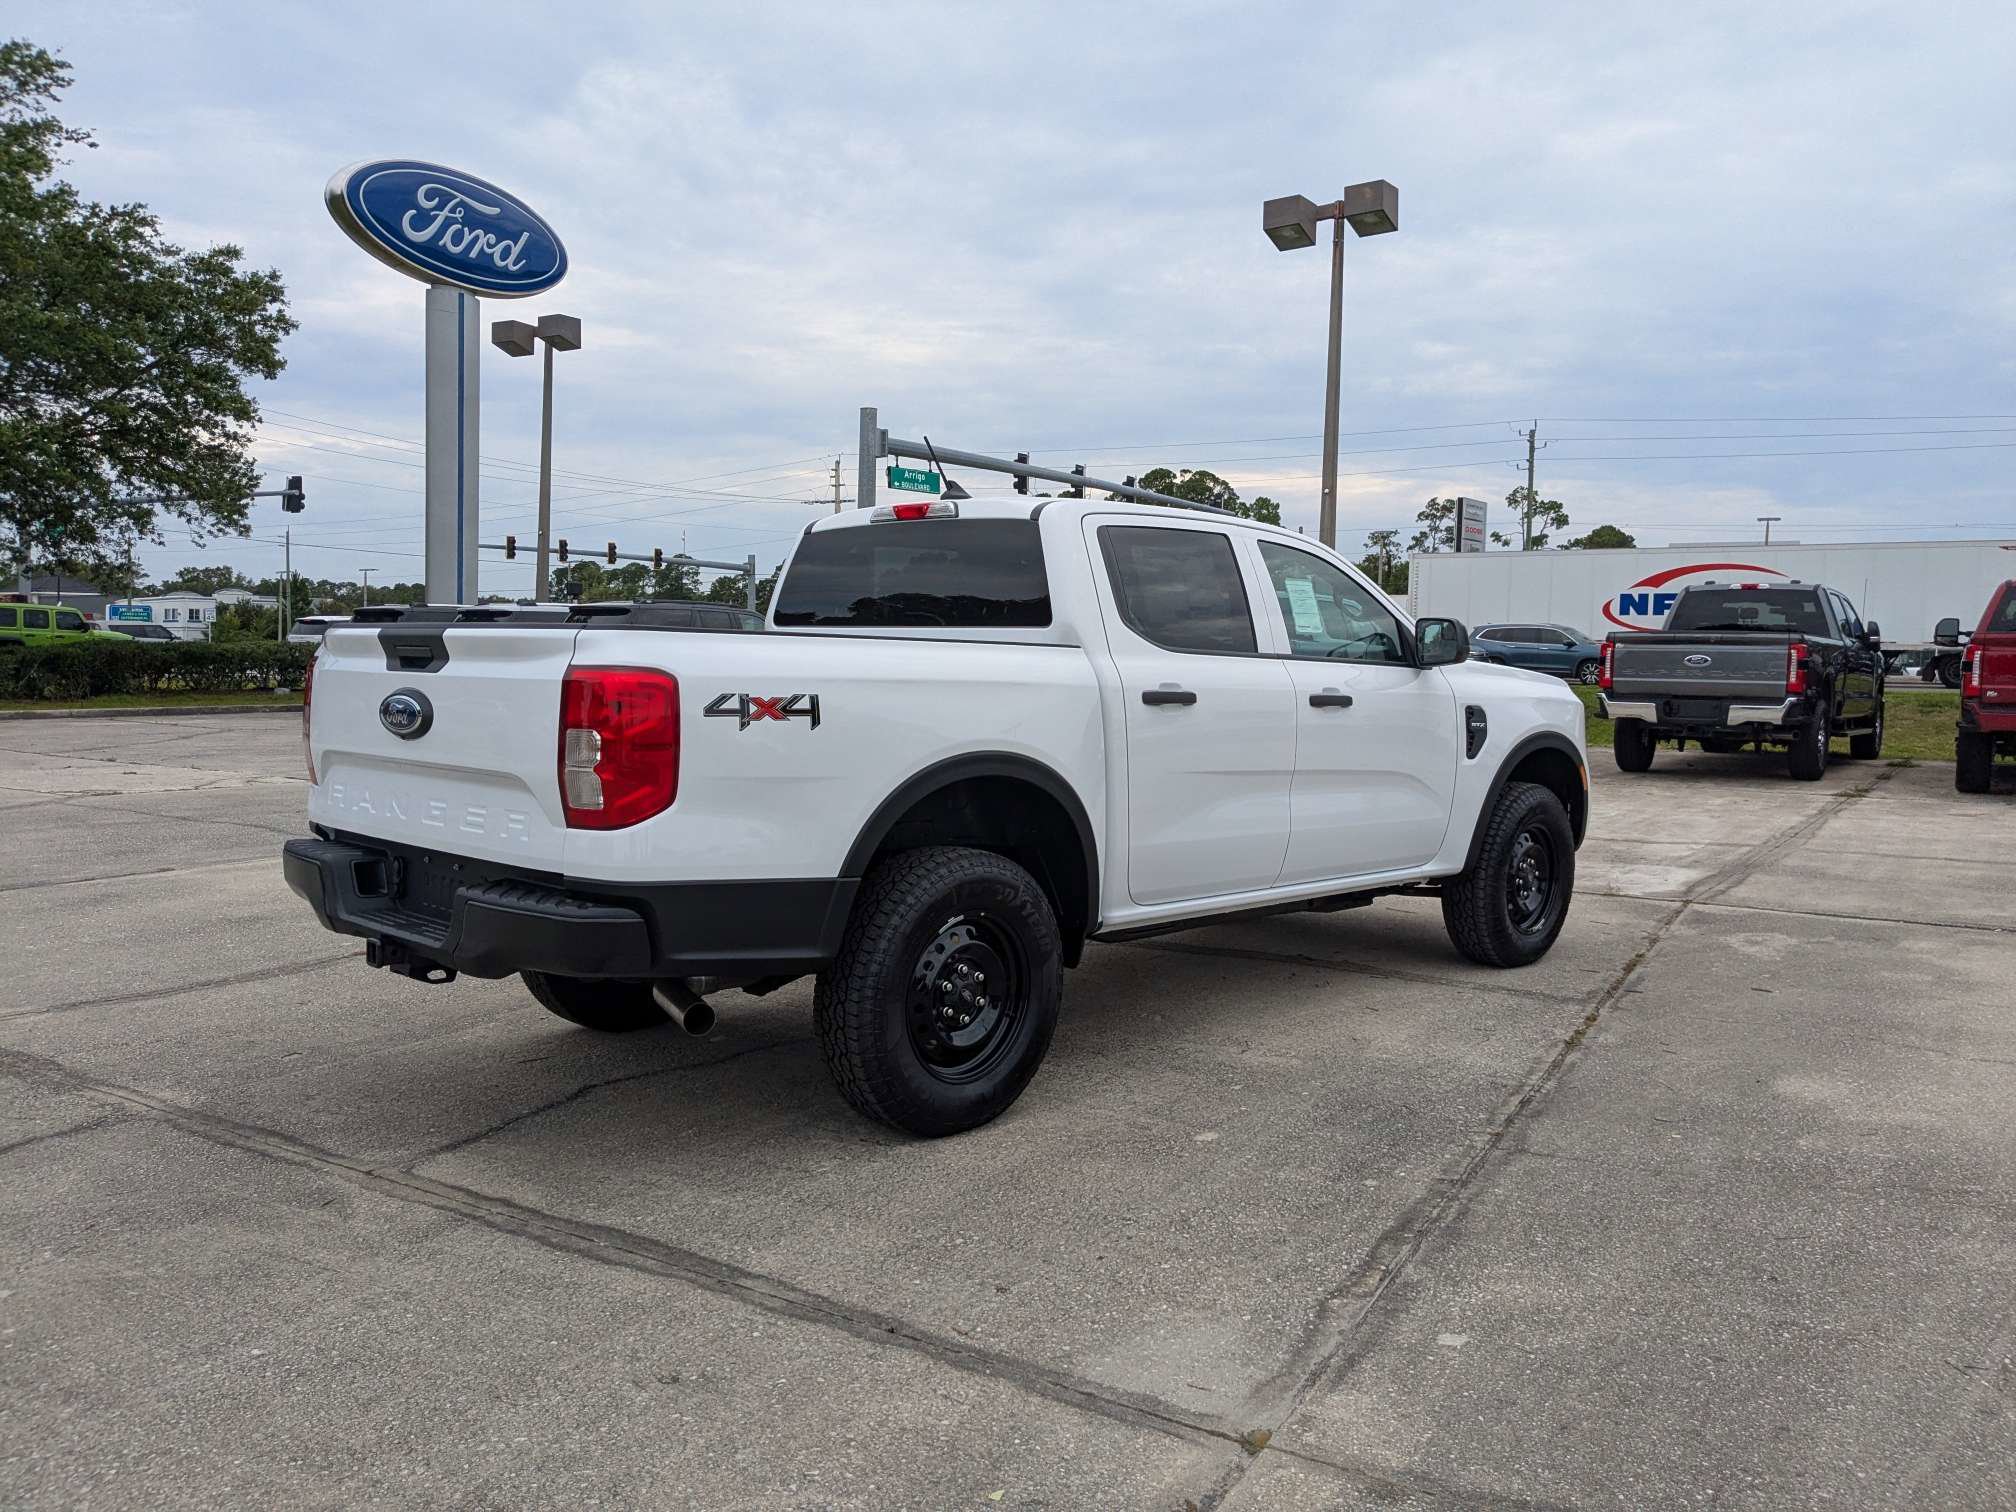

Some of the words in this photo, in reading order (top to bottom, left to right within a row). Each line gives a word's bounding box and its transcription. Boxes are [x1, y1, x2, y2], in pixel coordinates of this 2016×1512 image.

[402, 184, 529, 271] Ford
[901, 481, 931, 491] BOULEVARD
[904, 470, 925, 482] Arrigo
[328, 784, 530, 842] RANGER
